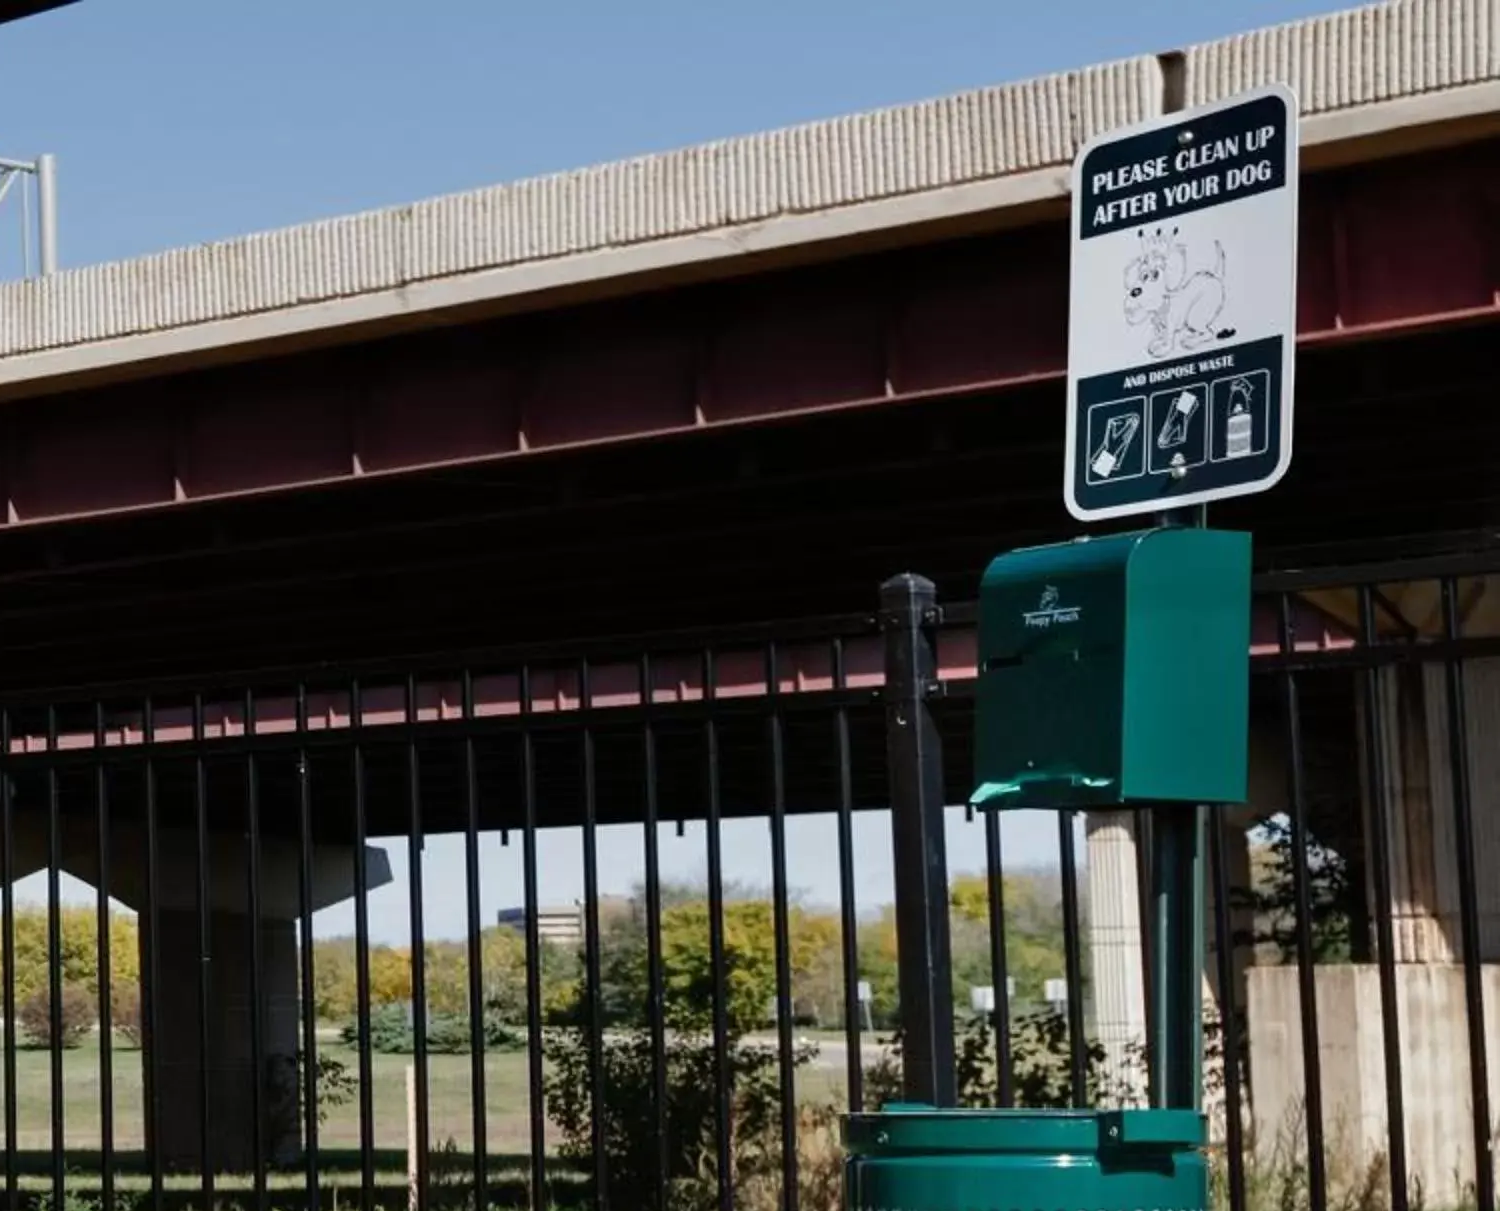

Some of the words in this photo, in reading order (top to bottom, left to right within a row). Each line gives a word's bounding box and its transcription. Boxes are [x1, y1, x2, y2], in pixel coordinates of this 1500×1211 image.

[1092, 156, 1169, 195] PLEASE
[1175, 135, 1240, 172] CLEAN
[1245, 124, 1276, 151] UP
[1092, 192, 1157, 227] AFTER
[1163, 175, 1220, 207] YOUR
[1226, 159, 1272, 191] DOG
[1123, 373, 1147, 389] AND
[1148, 363, 1197, 383] DISPOSE
[1198, 354, 1235, 373] WASTE
